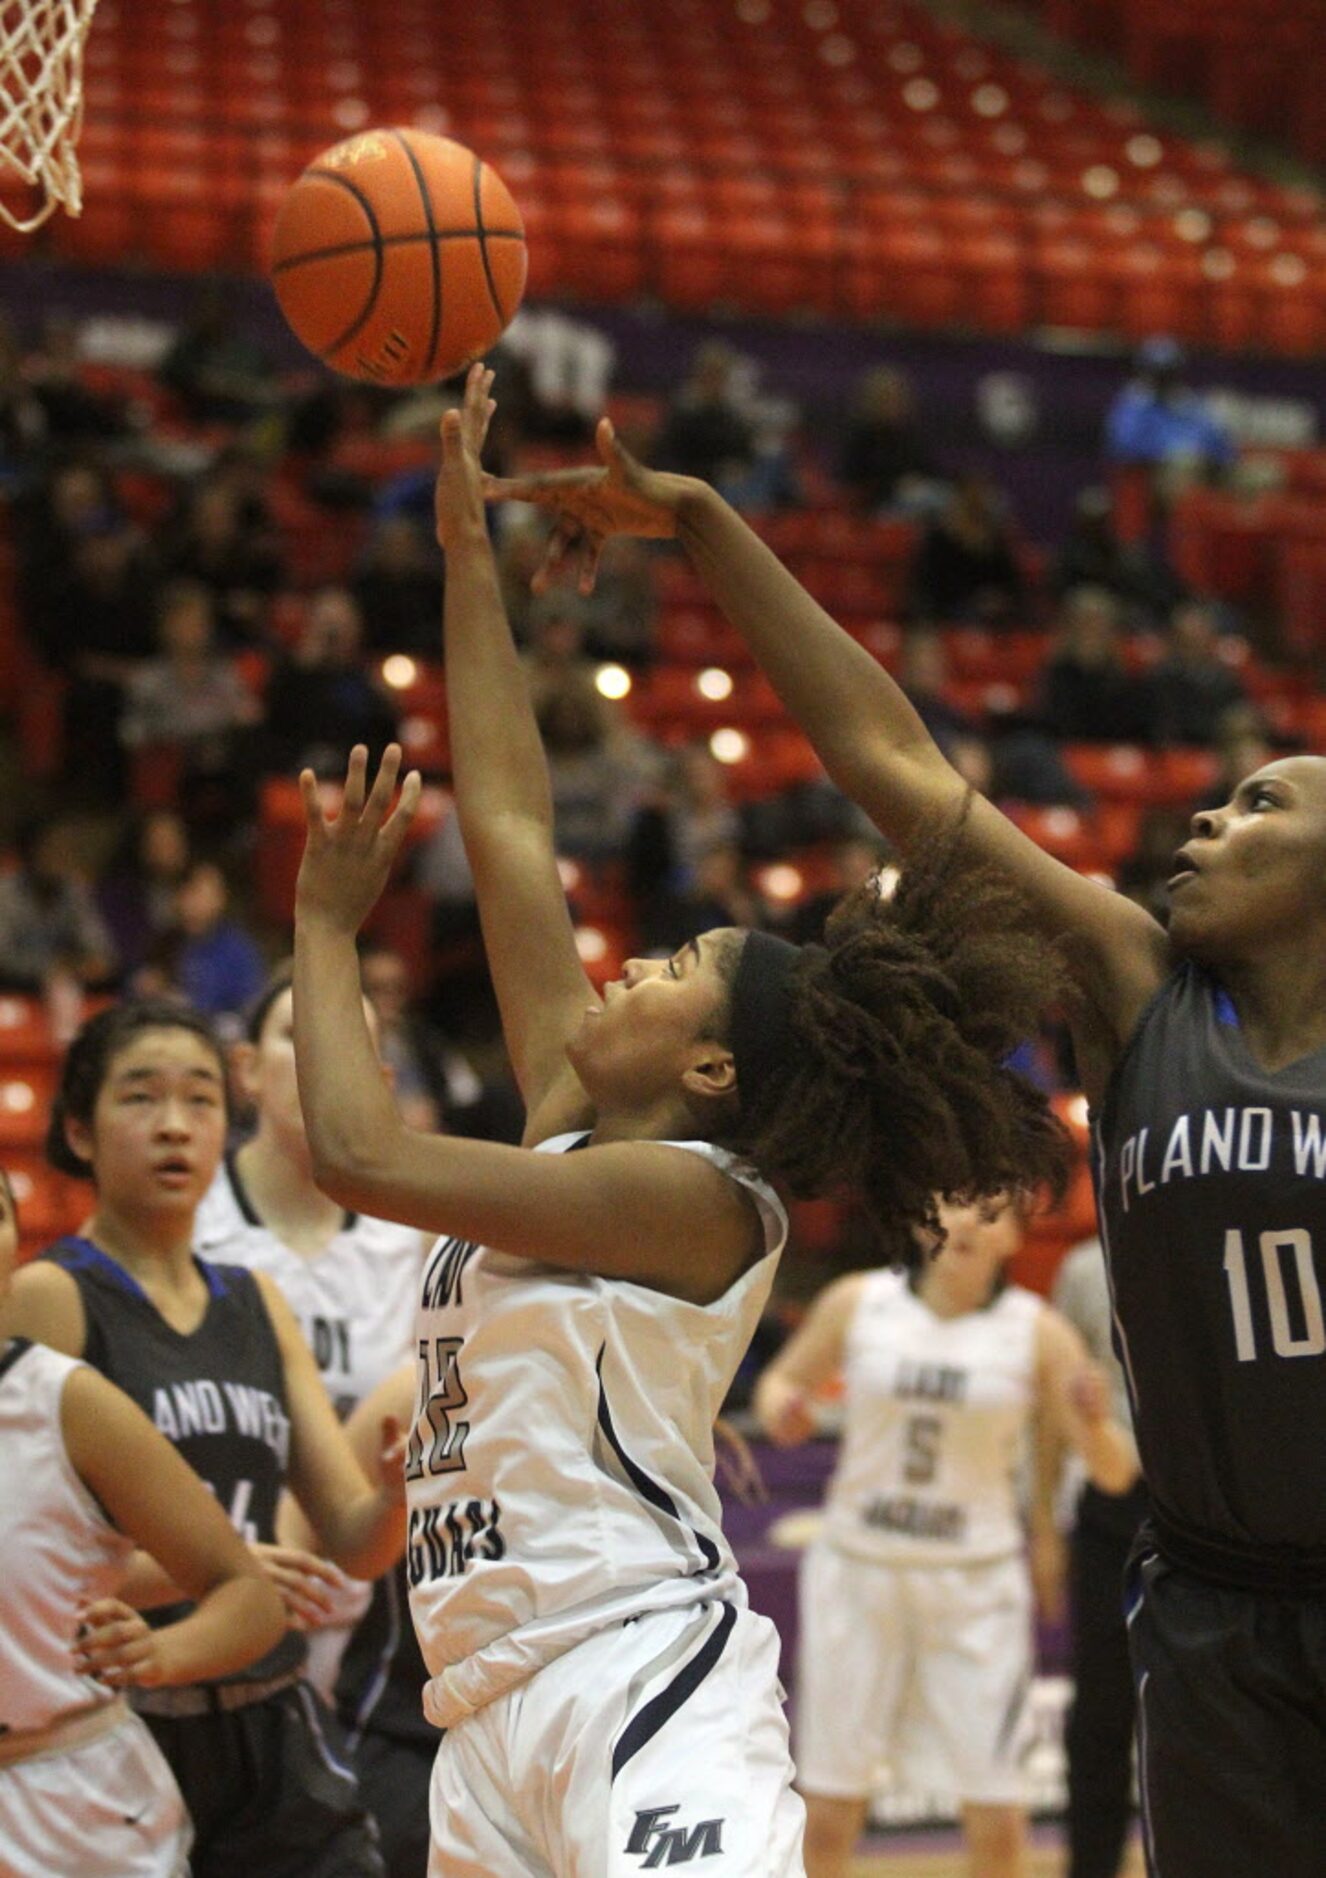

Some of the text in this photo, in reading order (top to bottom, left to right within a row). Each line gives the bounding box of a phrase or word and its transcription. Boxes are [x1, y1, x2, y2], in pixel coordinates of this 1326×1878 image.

[1120, 1107, 1273, 1212] PLANO
[1223, 1228, 1326, 1361] 10
[406, 1336, 470, 1481] 12
[623, 1803, 726, 1870] FM
